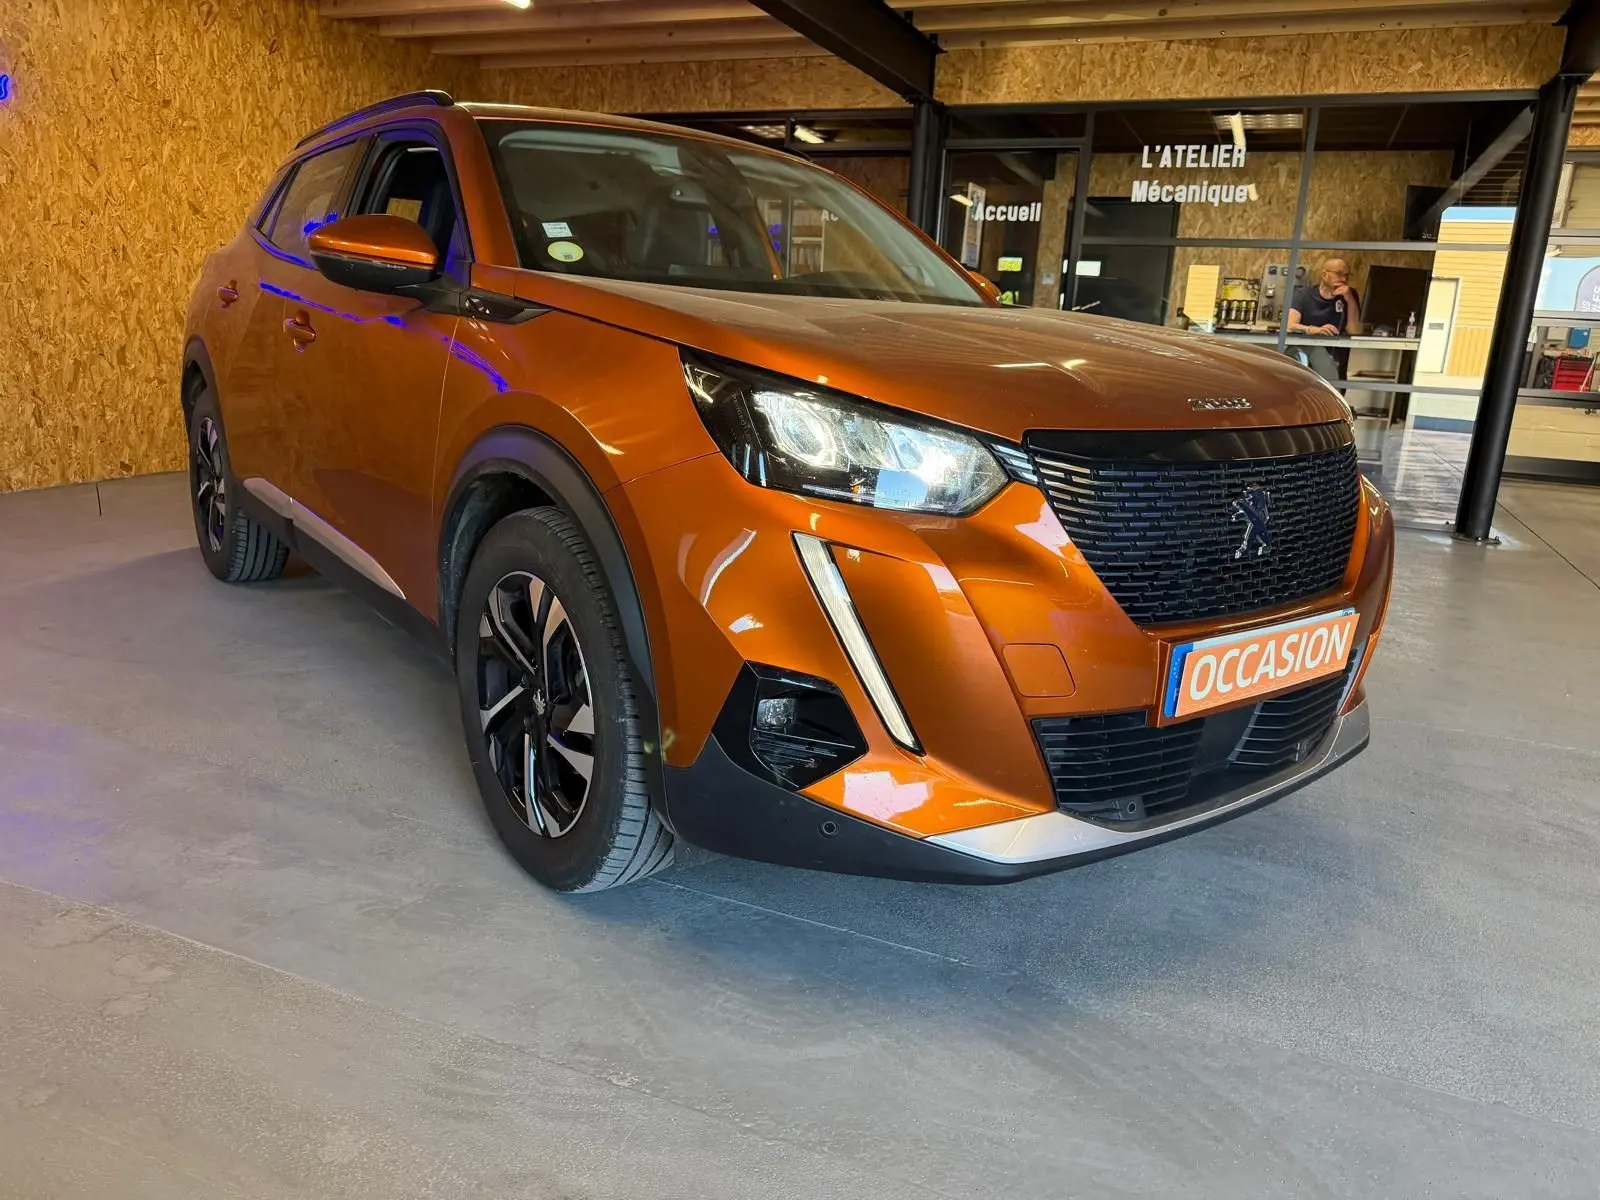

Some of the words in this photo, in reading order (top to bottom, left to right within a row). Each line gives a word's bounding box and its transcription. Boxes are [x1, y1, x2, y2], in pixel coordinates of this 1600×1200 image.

[1141, 144, 1246, 168] L'ATELIER
[1131, 180, 1248, 207] Mécanique
[974, 202, 1042, 222] Accueil
[1190, 621, 1352, 701] OCCASION
